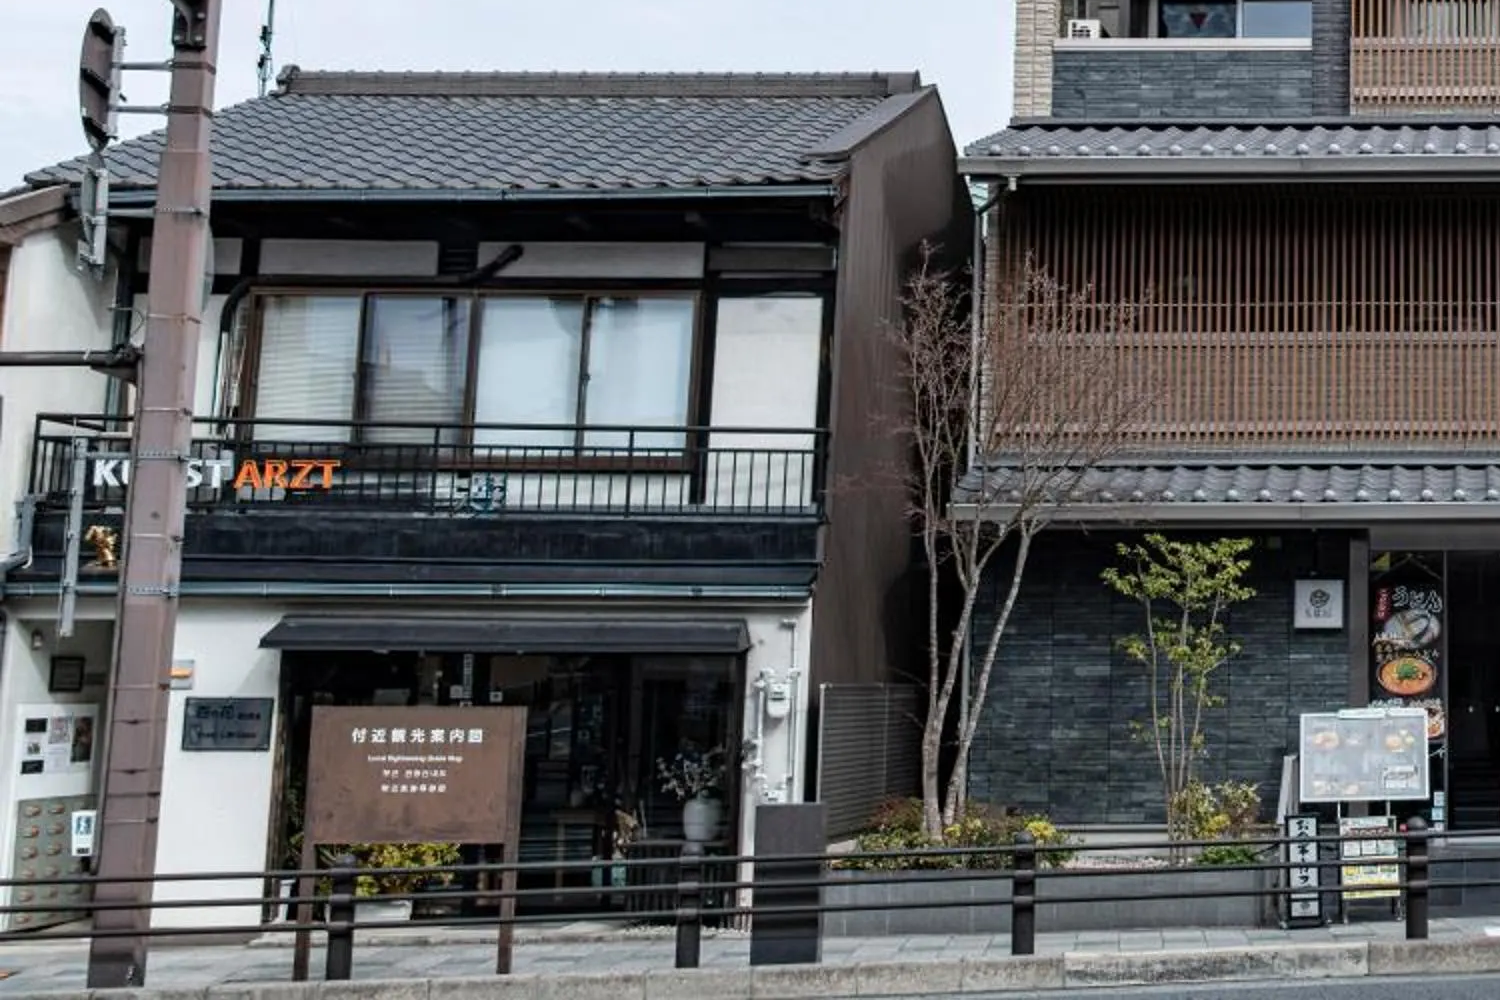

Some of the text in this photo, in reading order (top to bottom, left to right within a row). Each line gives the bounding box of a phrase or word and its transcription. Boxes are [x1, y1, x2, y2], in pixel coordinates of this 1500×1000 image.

[93, 458, 341, 489] KST ARZT
[351, 727, 483, 743] 付近観光案内図
